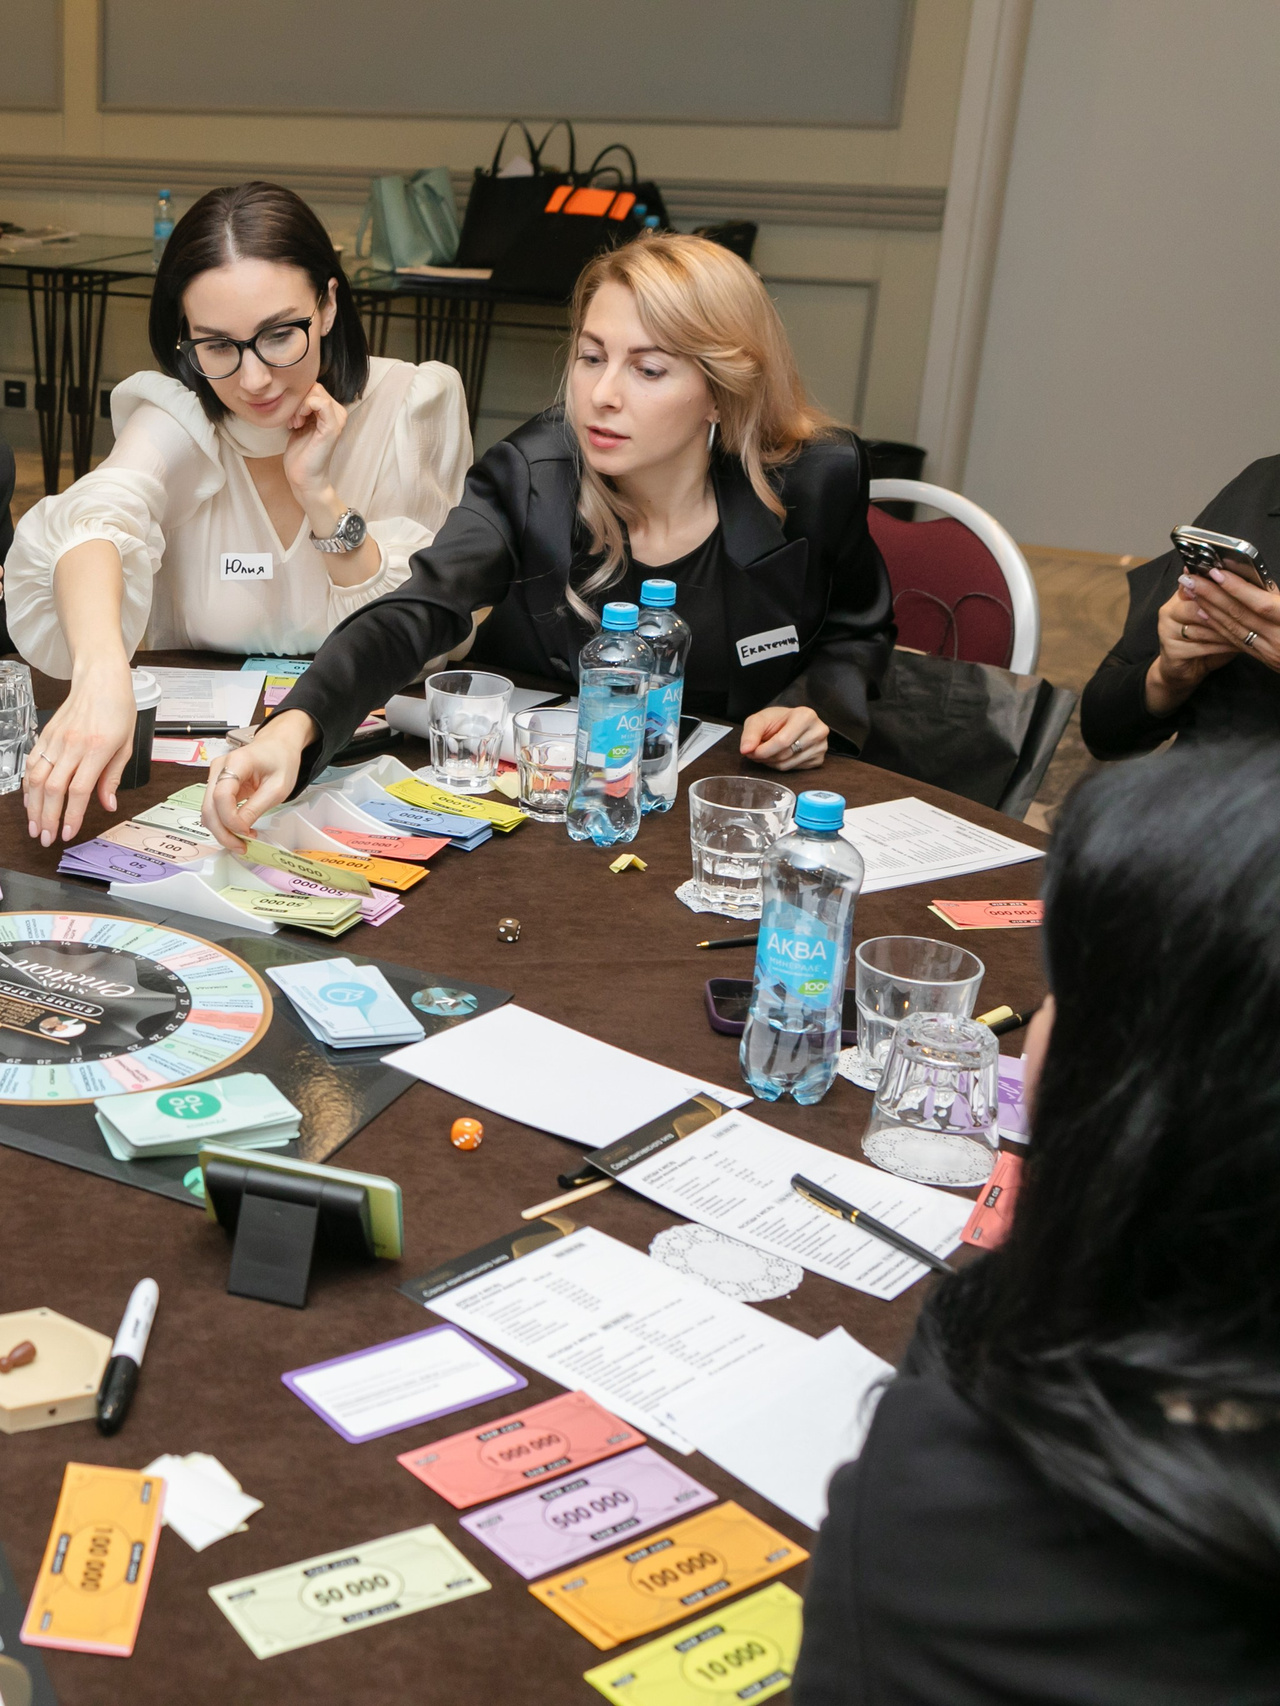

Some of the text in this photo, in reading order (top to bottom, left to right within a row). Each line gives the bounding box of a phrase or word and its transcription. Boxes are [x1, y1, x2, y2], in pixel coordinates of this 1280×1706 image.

[225, 558, 264, 575] Юлия
[616, 715, 646, 731] AQU
[438, 796, 477, 811] 10 000
[399, 811, 420, 820] 000
[158, 841, 182, 853] 100
[129, 861, 148, 870] 50
[280, 859, 323, 878] 50 000
[320, 857, 370, 870] 100 000
[292, 877, 345, 897] 500 000
[259, 898, 284, 907] 000
[767, 932, 827, 962] АКВА
[14, 959, 135, 997] emotion
[488, 1433, 561, 1466] 1 000 000
[552, 1505, 592, 1530] 500
[590, 1491, 630, 1513] 000
[81, 1527, 113, 1592] 100 000
[638, 1551, 718, 1592] 100 000
[314, 1574, 390, 1607] 50 000
[696, 1641, 767, 1682] 10 000
